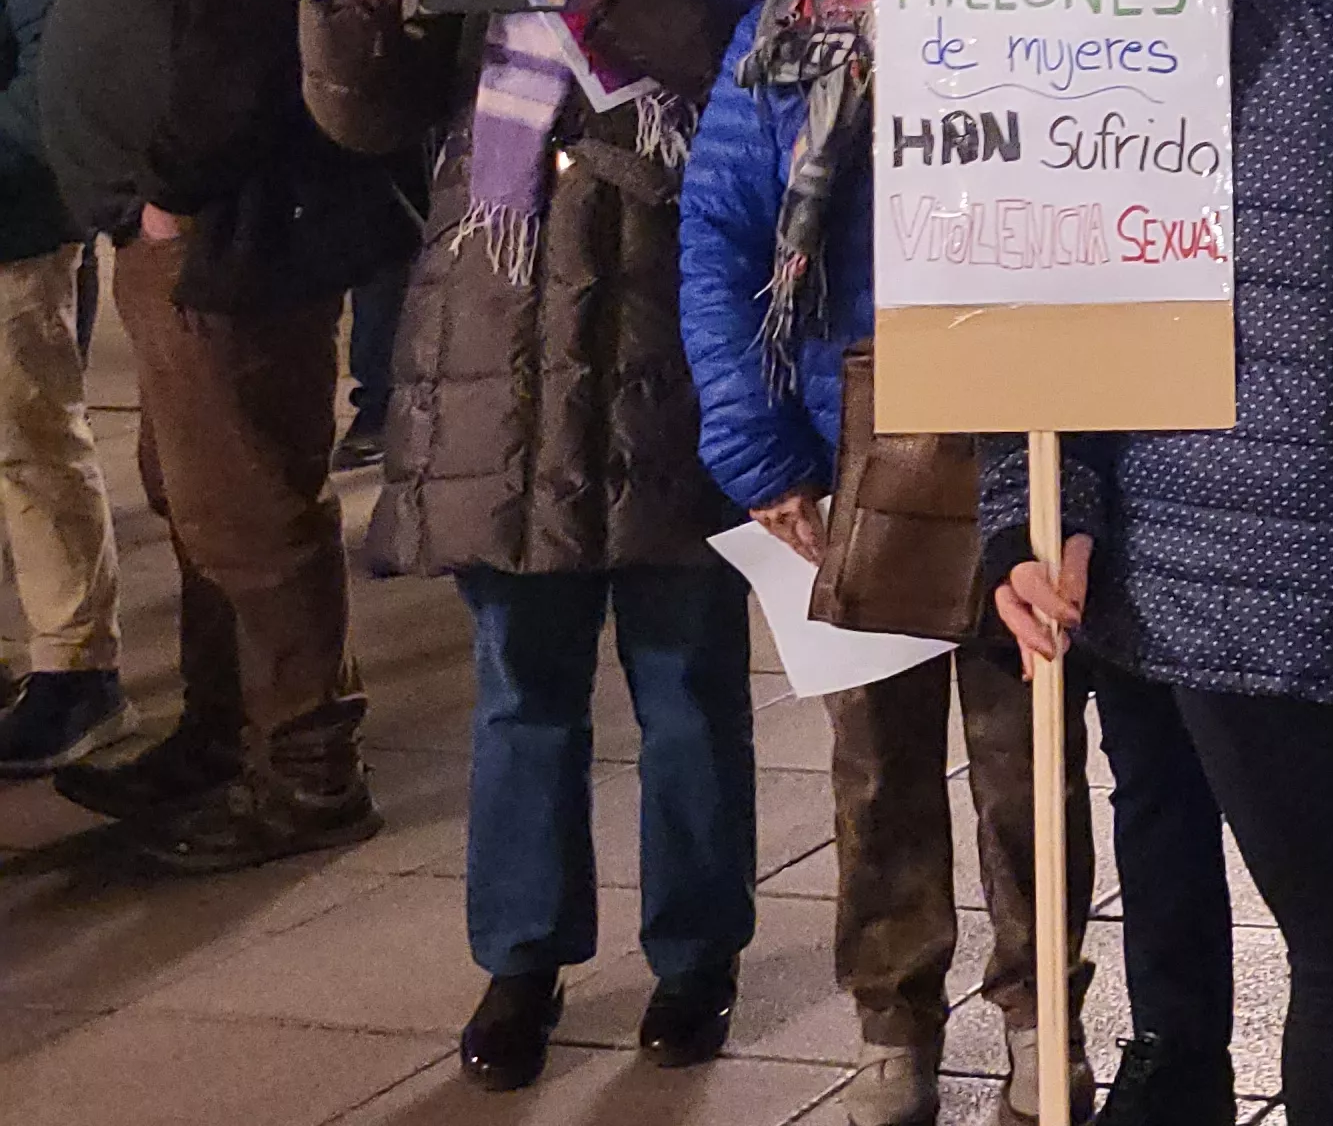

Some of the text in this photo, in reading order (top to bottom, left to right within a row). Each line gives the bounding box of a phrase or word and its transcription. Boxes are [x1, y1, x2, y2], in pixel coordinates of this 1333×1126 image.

[922, 16, 1179, 91] de mujeres
[892, 109, 1221, 175] HAN Sufrido
[889, 193, 1229, 270] VIOLENCIA SEXUAL
